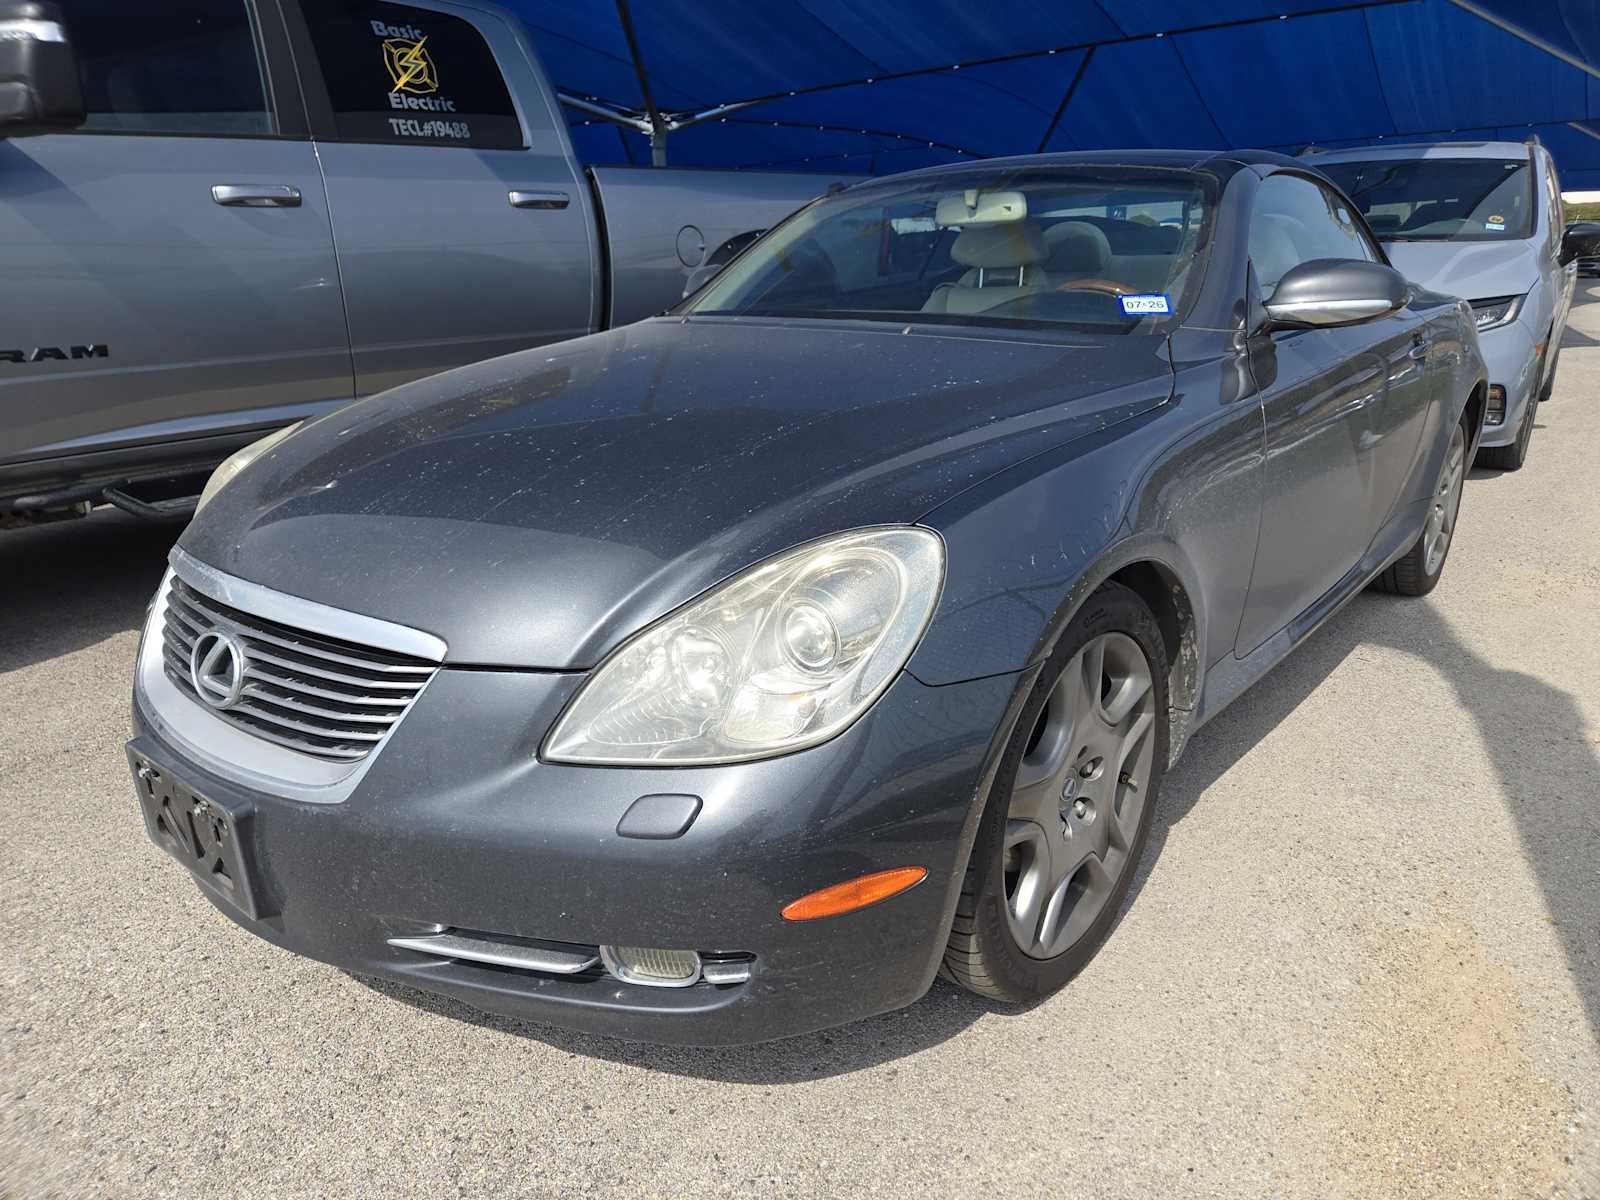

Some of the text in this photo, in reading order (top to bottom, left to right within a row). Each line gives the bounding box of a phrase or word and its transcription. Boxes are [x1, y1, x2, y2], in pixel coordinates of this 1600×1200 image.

[370, 20, 425, 40] Basic
[388, 92, 456, 112] Electric
[388, 118, 471, 138] TECL#19488
[0, 344, 109, 363] RAM
